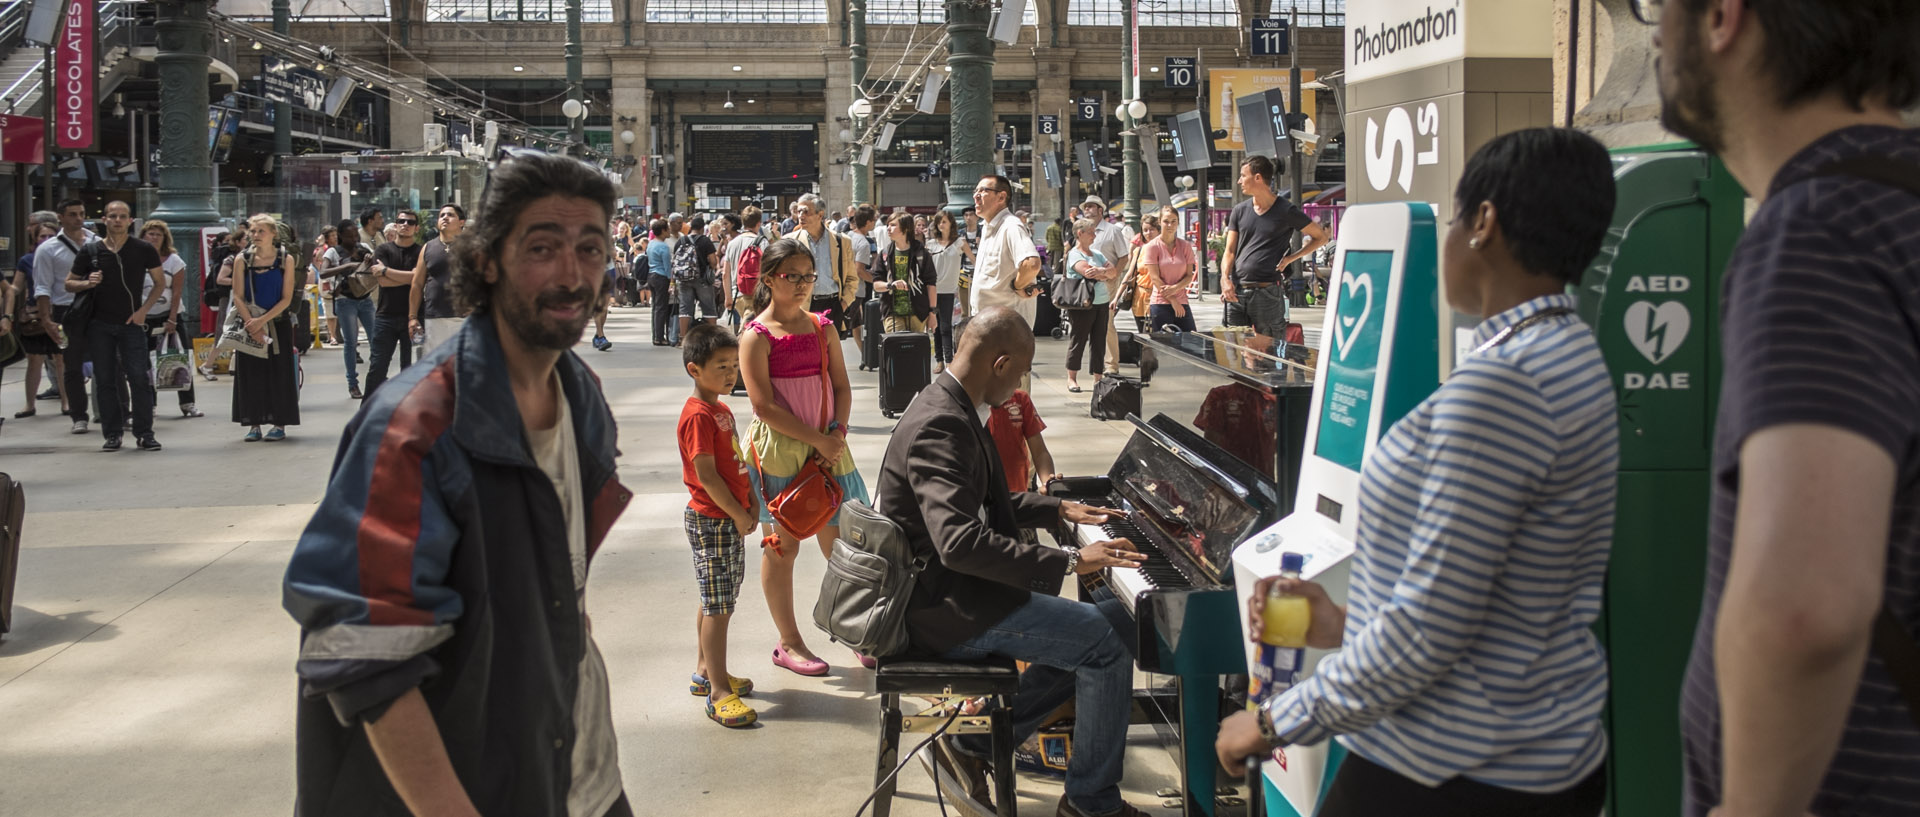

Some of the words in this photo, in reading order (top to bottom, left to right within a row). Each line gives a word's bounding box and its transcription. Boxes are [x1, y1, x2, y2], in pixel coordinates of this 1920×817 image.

[1261, 20, 1279, 28] Voie
[1260, 32, 1280, 53] 11
[1354, 6, 1456, 65] Photomaton
[1173, 57, 1188, 65] Voie
[67, 2, 82, 140] CHOCOLATES
[1171, 68, 1191, 86] 10
[1084, 105, 1095, 119] 9
[1043, 121, 1053, 134] 8
[1273, 114, 1285, 136] 11
[1000, 138, 1008, 149] 7
[930, 167, 936, 175] 3
[1625, 275, 1691, 293] AED
[1624, 372, 1690, 390] DAE
[1048, 756, 1067, 764] ALDI
